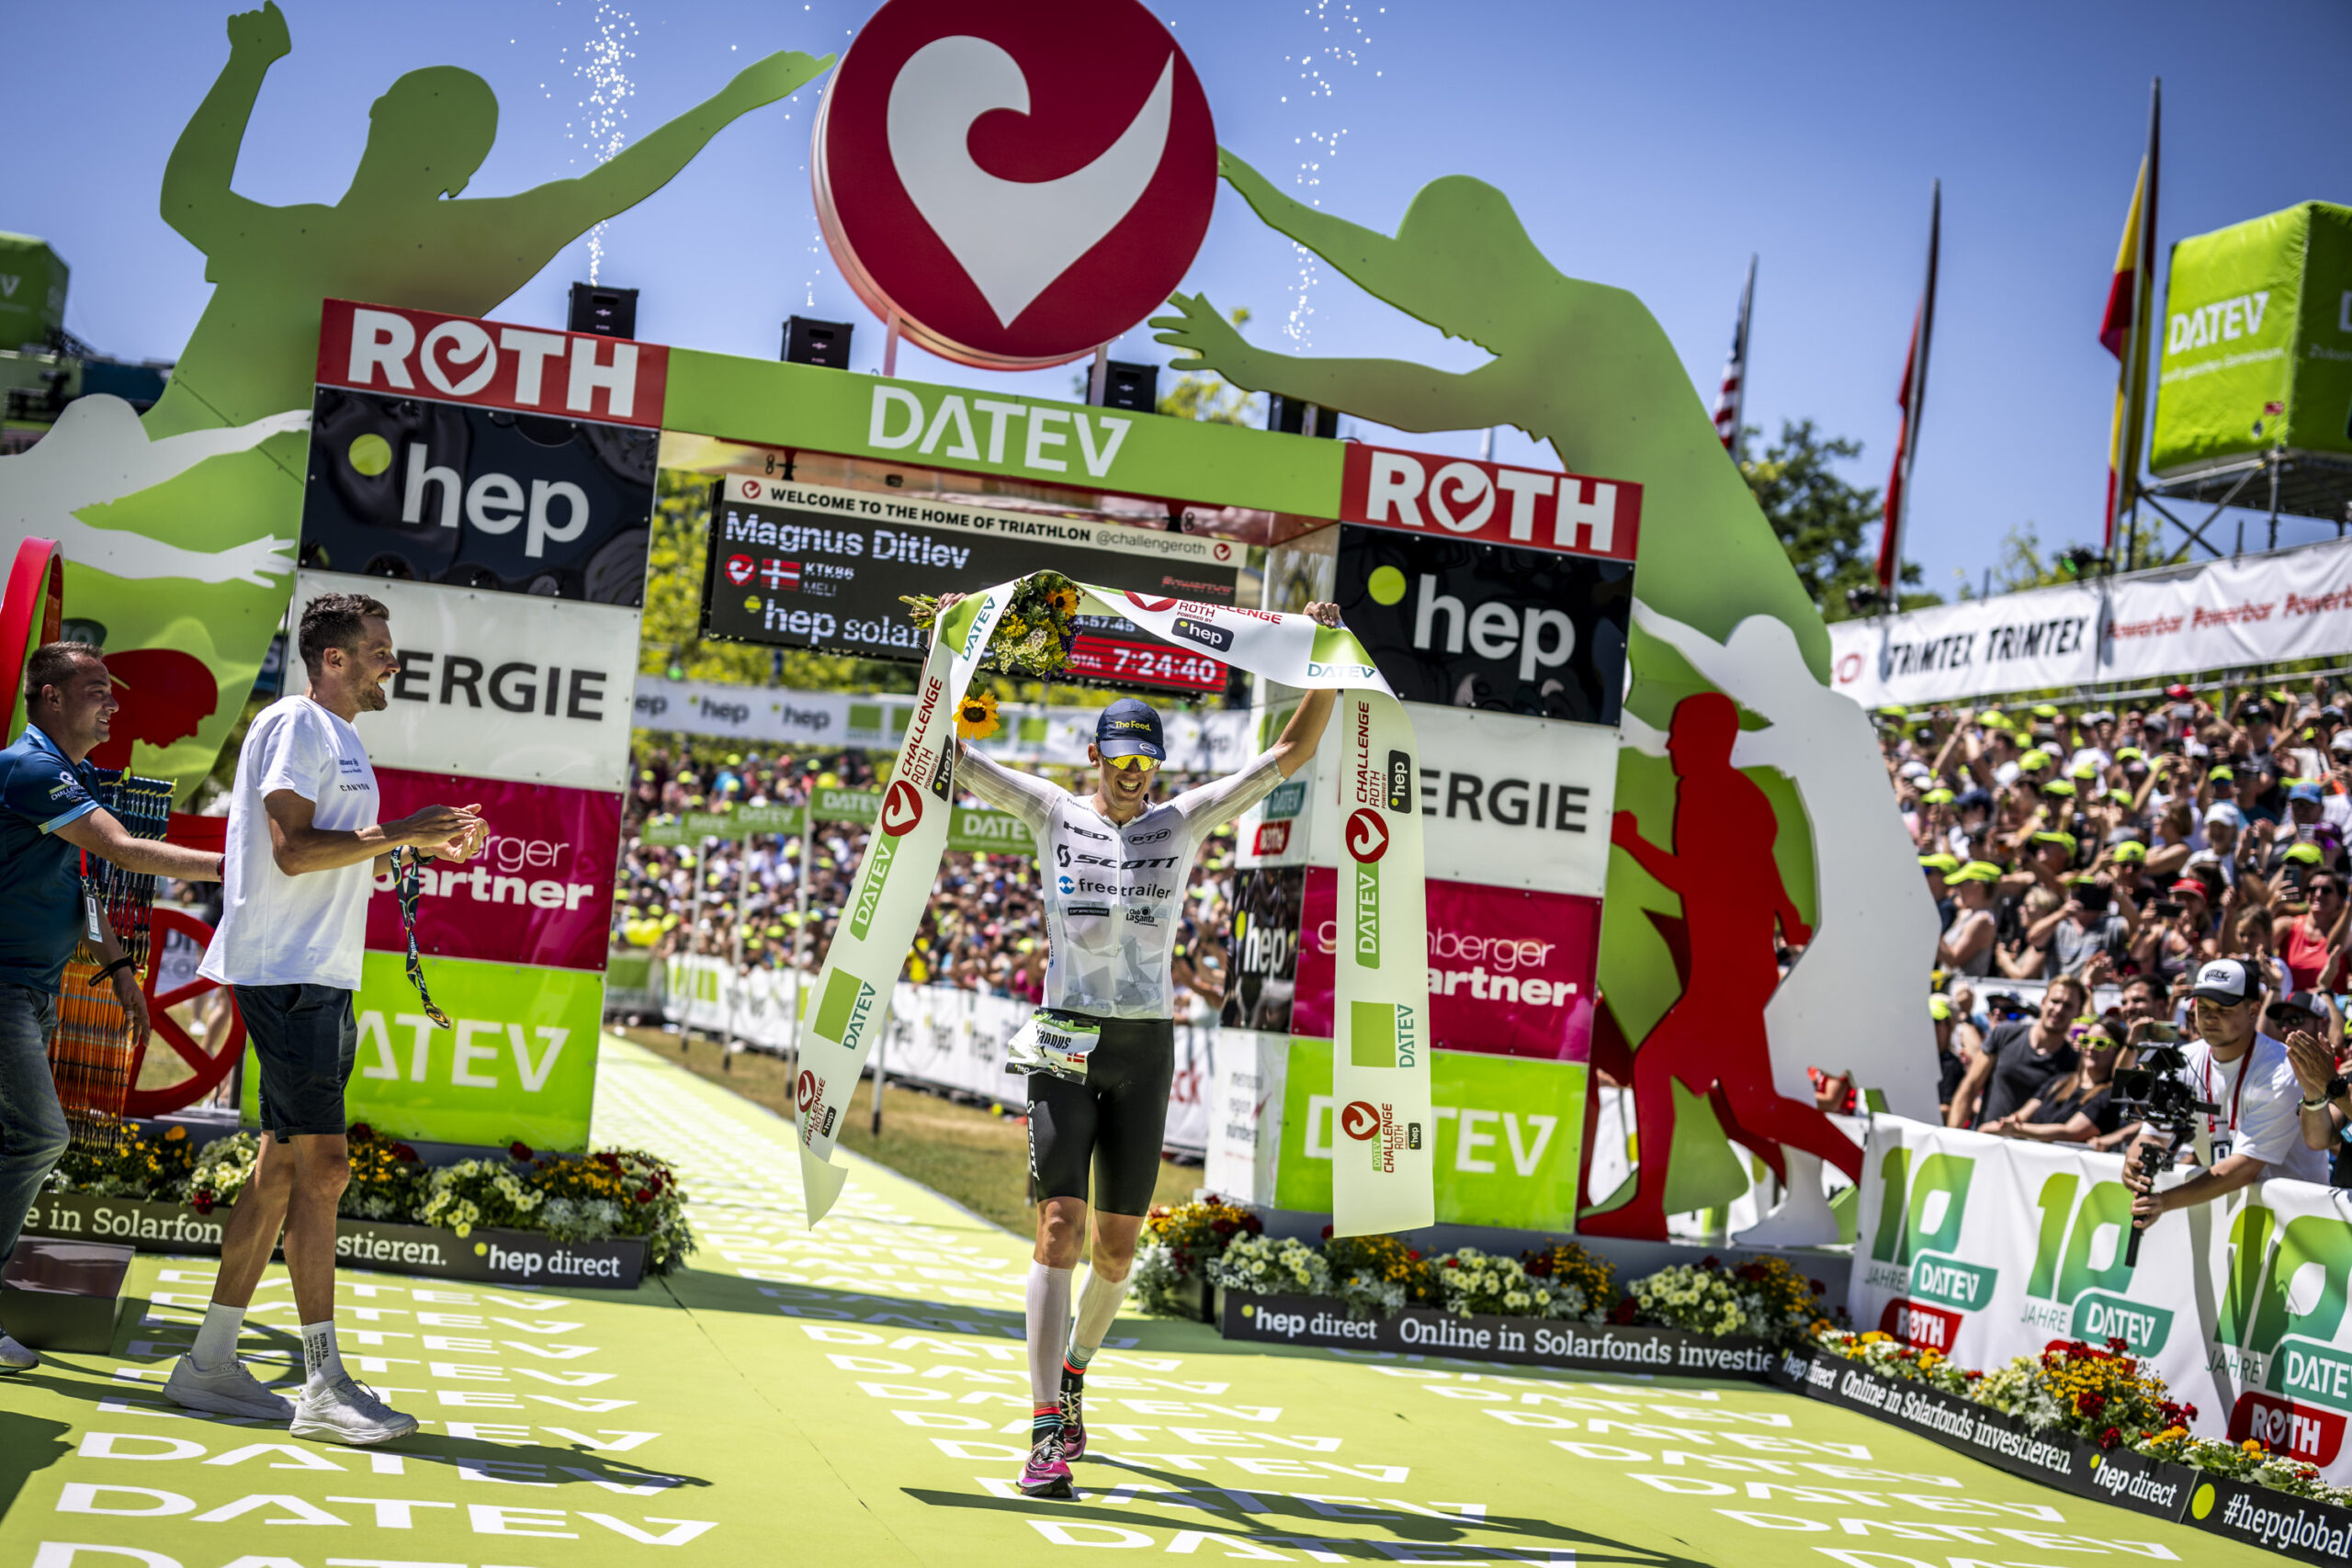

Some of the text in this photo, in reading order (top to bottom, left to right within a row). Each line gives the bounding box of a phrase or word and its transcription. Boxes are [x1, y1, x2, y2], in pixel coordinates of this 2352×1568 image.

[2169, 291, 2269, 355] DATEV
[347, 309, 639, 418] ROTH
[868, 385, 1132, 478] DATEV
[401, 443, 590, 558] hep
[771, 488, 1206, 556] WELCOME TO THE HOME OF TRIATHLON @challengeroth
[1366, 451, 1617, 552] ROTH
[725, 511, 971, 570] Magnus Ditlev
[764, 598, 837, 645] hep
[963, 597, 995, 662] DATEV
[1179, 602, 1216, 618] ROTH
[1189, 623, 1223, 645] hep
[1414, 573, 1576, 681] hep
[2193, 602, 2277, 628] Powerbar
[1070, 648, 1217, 683] OTAL 7:24:40
[1307, 663, 1376, 679] DATEV
[1888, 616, 2088, 678] TRIMTEX TRIMTEX
[392, 649, 606, 721] ERGIE
[634, 694, 831, 731] ep hep hep
[902, 676, 943, 777] CHALLENGE
[1131, 720, 1152, 731] Feed.
[910, 747, 933, 786] ROTH
[943, 748, 953, 784] hep
[1355, 701, 1371, 804] CHALLENGE
[340, 784, 370, 792] CANYON
[1370, 771, 1381, 808] ROTH
[1392, 761, 1408, 802] hep
[1419, 768, 1589, 833] ERGIE
[962, 813, 1031, 840] DATE
[855, 841, 887, 926] DATEV
[1074, 853, 1179, 870] SCOTT
[1079, 878, 1171, 899] freetrailer
[1358, 872, 1377, 955] DATEV
[1243, 911, 1286, 986] hep
[1428, 965, 1577, 1008] artner
[842, 981, 876, 1051] DATEV
[1396, 1004, 1416, 1068] DATEV
[356, 1010, 571, 1093] ATEV
[806, 1077, 826, 1149] HALLENGE
[813, 1103, 826, 1133] ROTH
[823, 1111, 833, 1131] hep
[1304, 1095, 1559, 1177] DEV
[1382, 1102, 1395, 1174] CHALLENGE
[1395, 1124, 1404, 1150] ROTH
[1410, 1126, 1419, 1145] hep
[49, 1201, 82, 1232] in
[93, 1206, 222, 1244] Solarfon
[336, 1231, 447, 1267] stieren.
[489, 1244, 542, 1278] hep
[547, 1250, 620, 1279] direct
[1865, 1266, 1907, 1292] JAHRE
[1918, 1261, 1981, 1303] DATEV
[1256, 1306, 1306, 1337] hep
[1310, 1313, 1378, 1340] direct
[1400, 1316, 1492, 1349] Online
[1497, 1324, 1527, 1353] in
[1533, 1327, 1672, 1366] Solarfonds
[1896, 1306, 1946, 1348] ROTH
[2021, 1303, 2067, 1333] JAHRE
[2085, 1302, 2156, 1348] DATEV
[799, 1325, 1183, 1372] DATV
[2205, 1349, 2263, 1385] JAHRE
[2286, 1350, 2352, 1400] DATE
[96, 1395, 663, 1451] DEV
[1421, 1385, 1793, 1427] DATEV
[2252, 1403, 2322, 1457] ROTH
[1481, 1408, 1873, 1461] DATEV
[1781, 1352, 2352, 1559] hep direct Online in Solarfonds investieren. hep direct #hepglobal
[77, 1431, 687, 1496] DATEV
[1549, 1439, 1964, 1488] DATEV
[55, 1482, 720, 1546] DATEV
[1624, 1472, 2067, 1523] DATEV
[1711, 1508, 2183, 1562] DATEV
